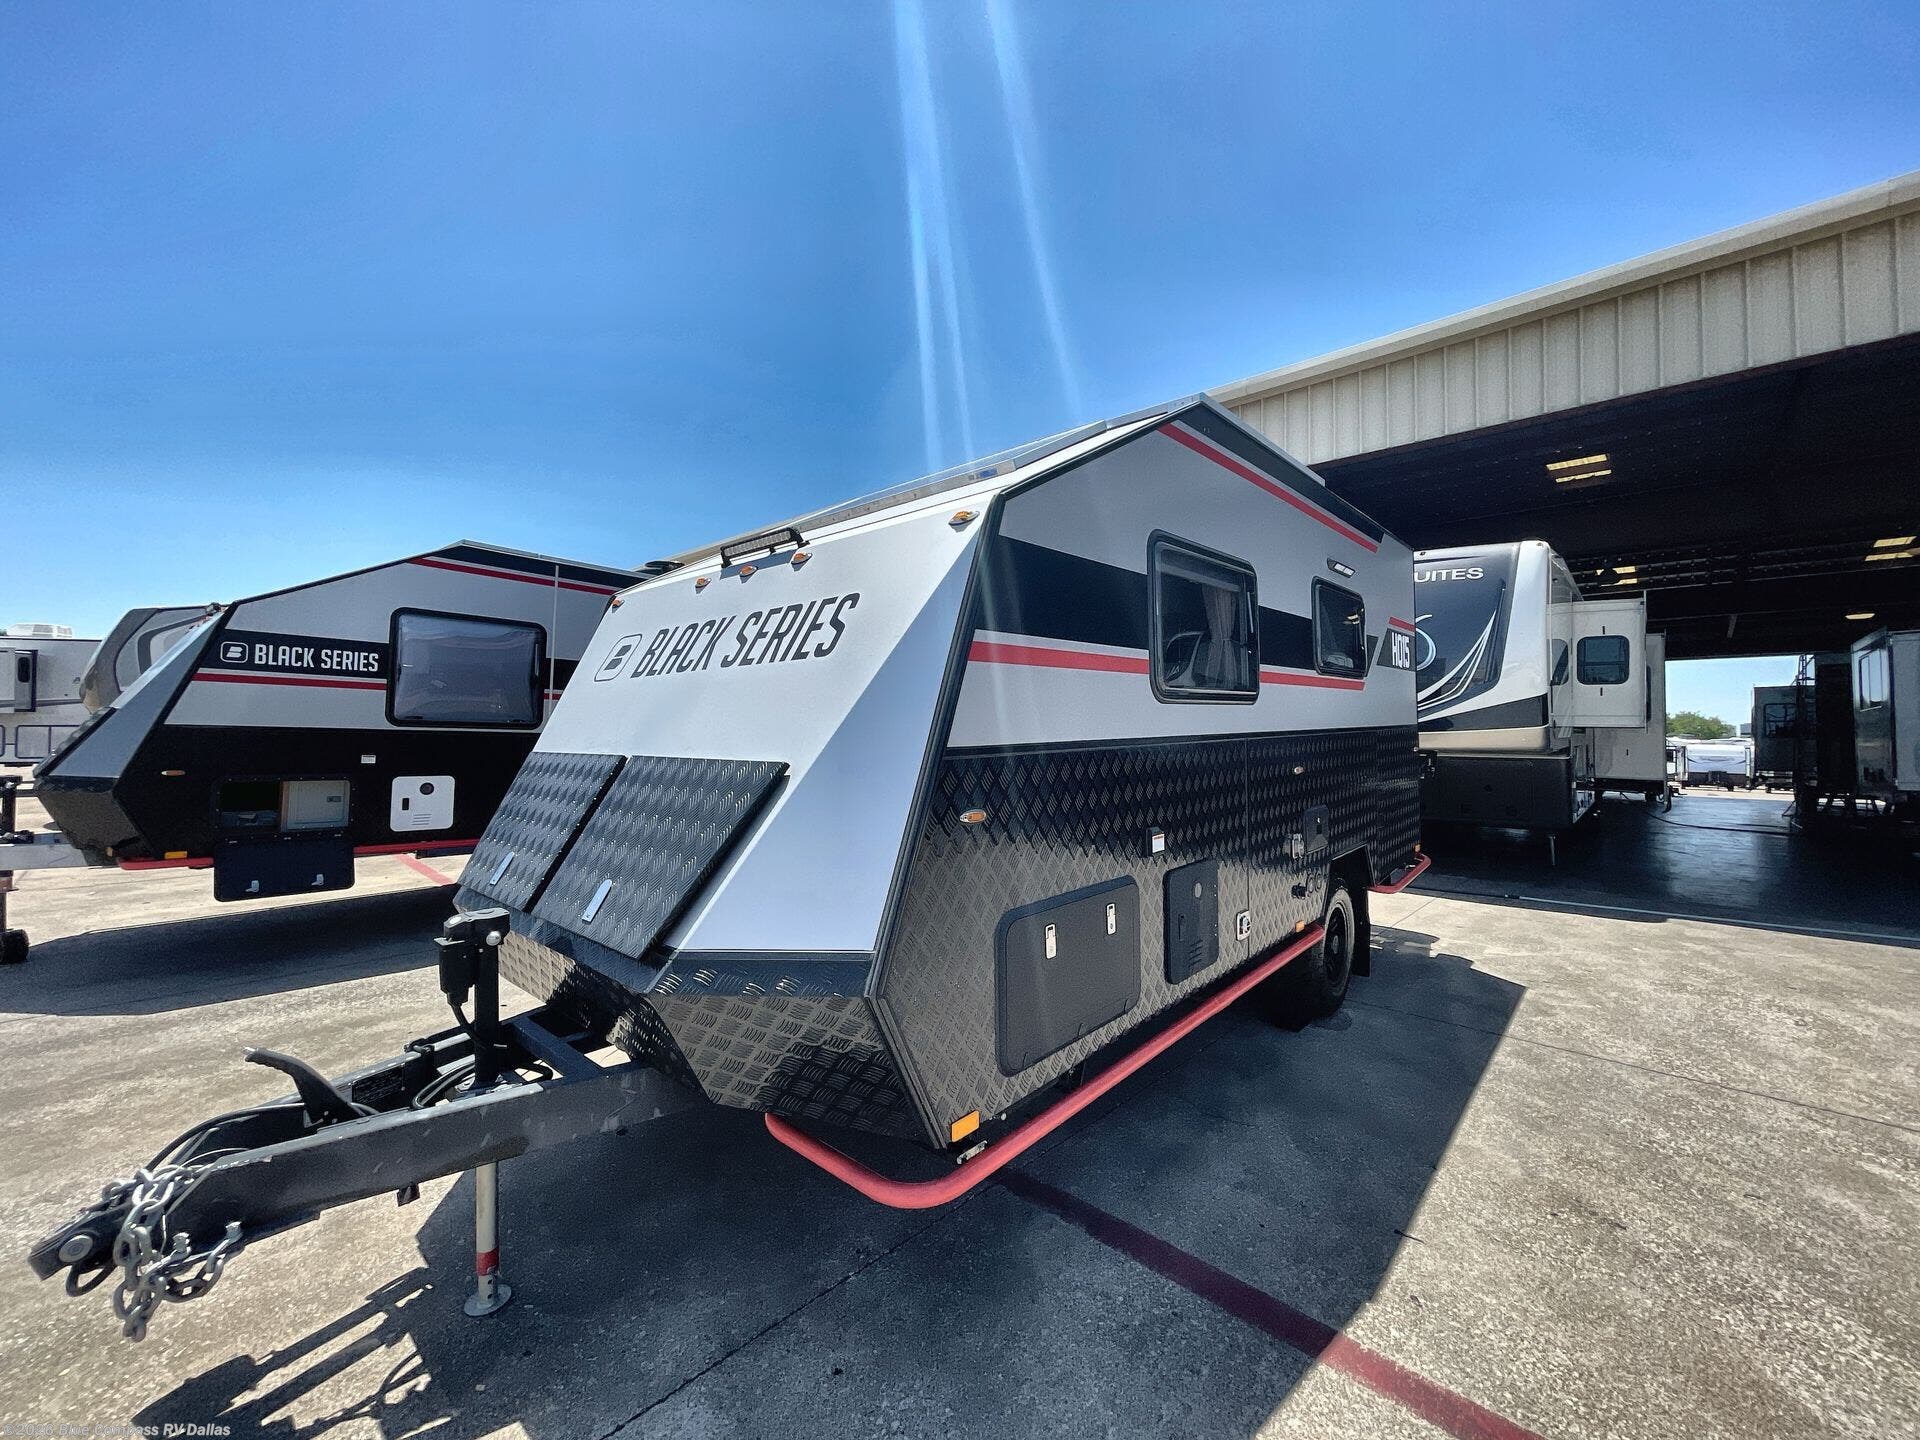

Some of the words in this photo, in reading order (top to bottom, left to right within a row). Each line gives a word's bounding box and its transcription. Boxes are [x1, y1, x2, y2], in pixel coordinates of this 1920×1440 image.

[630, 615, 736, 679] BLACK
[720, 592, 861, 668] SERIES
[1391, 631, 1410, 669] HQ15
[254, 643, 315, 668] BLACK
[320, 649, 379, 672] SERIES
